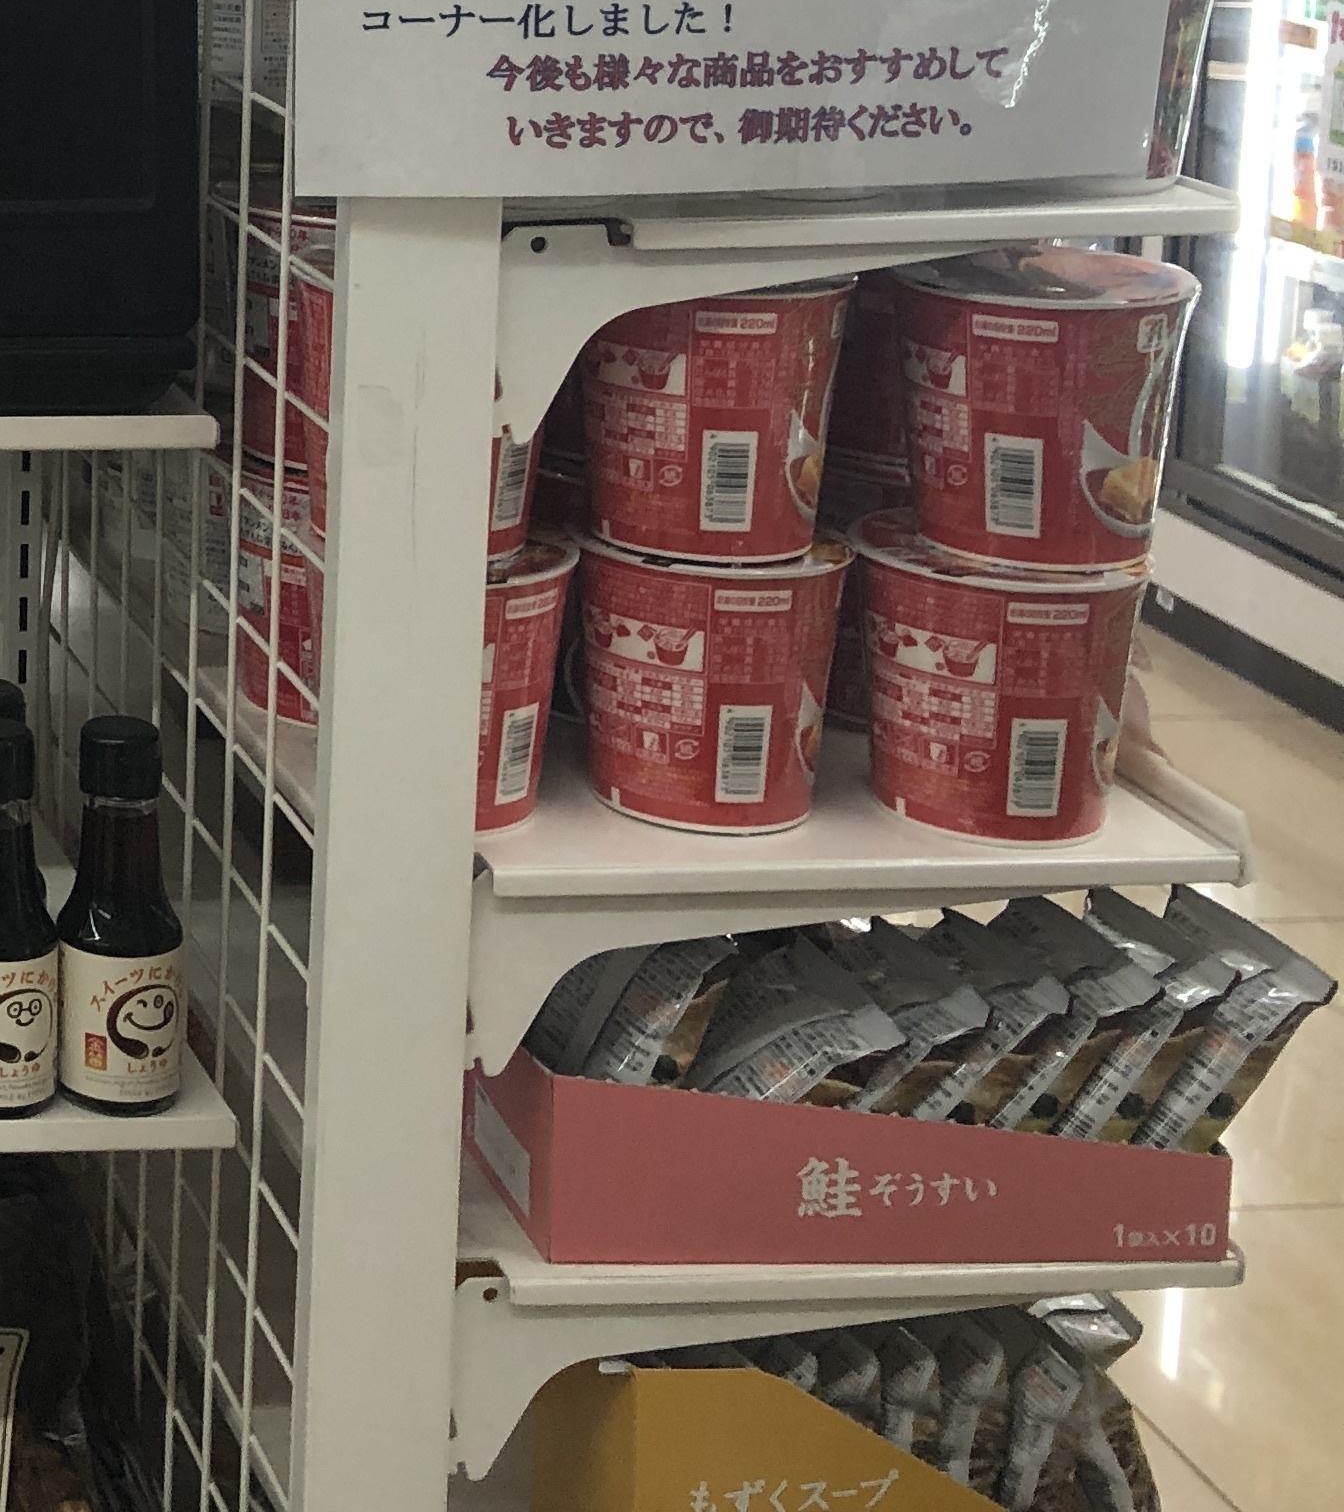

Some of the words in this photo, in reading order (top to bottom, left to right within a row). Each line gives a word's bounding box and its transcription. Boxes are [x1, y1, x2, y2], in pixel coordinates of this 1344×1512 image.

[361, 1, 736, 39] コーナー化しました！
[487, 47, 1008, 94] 今後も様々な商品をおすすめして
[506, 103, 975, 148] いきますので、御期待ください。
[0, 1062, 40, 1079] しょうゆ
[126, 1058, 169, 1075] しょうゆ
[796, 1156, 999, 1219] 鮭ぞうすい
